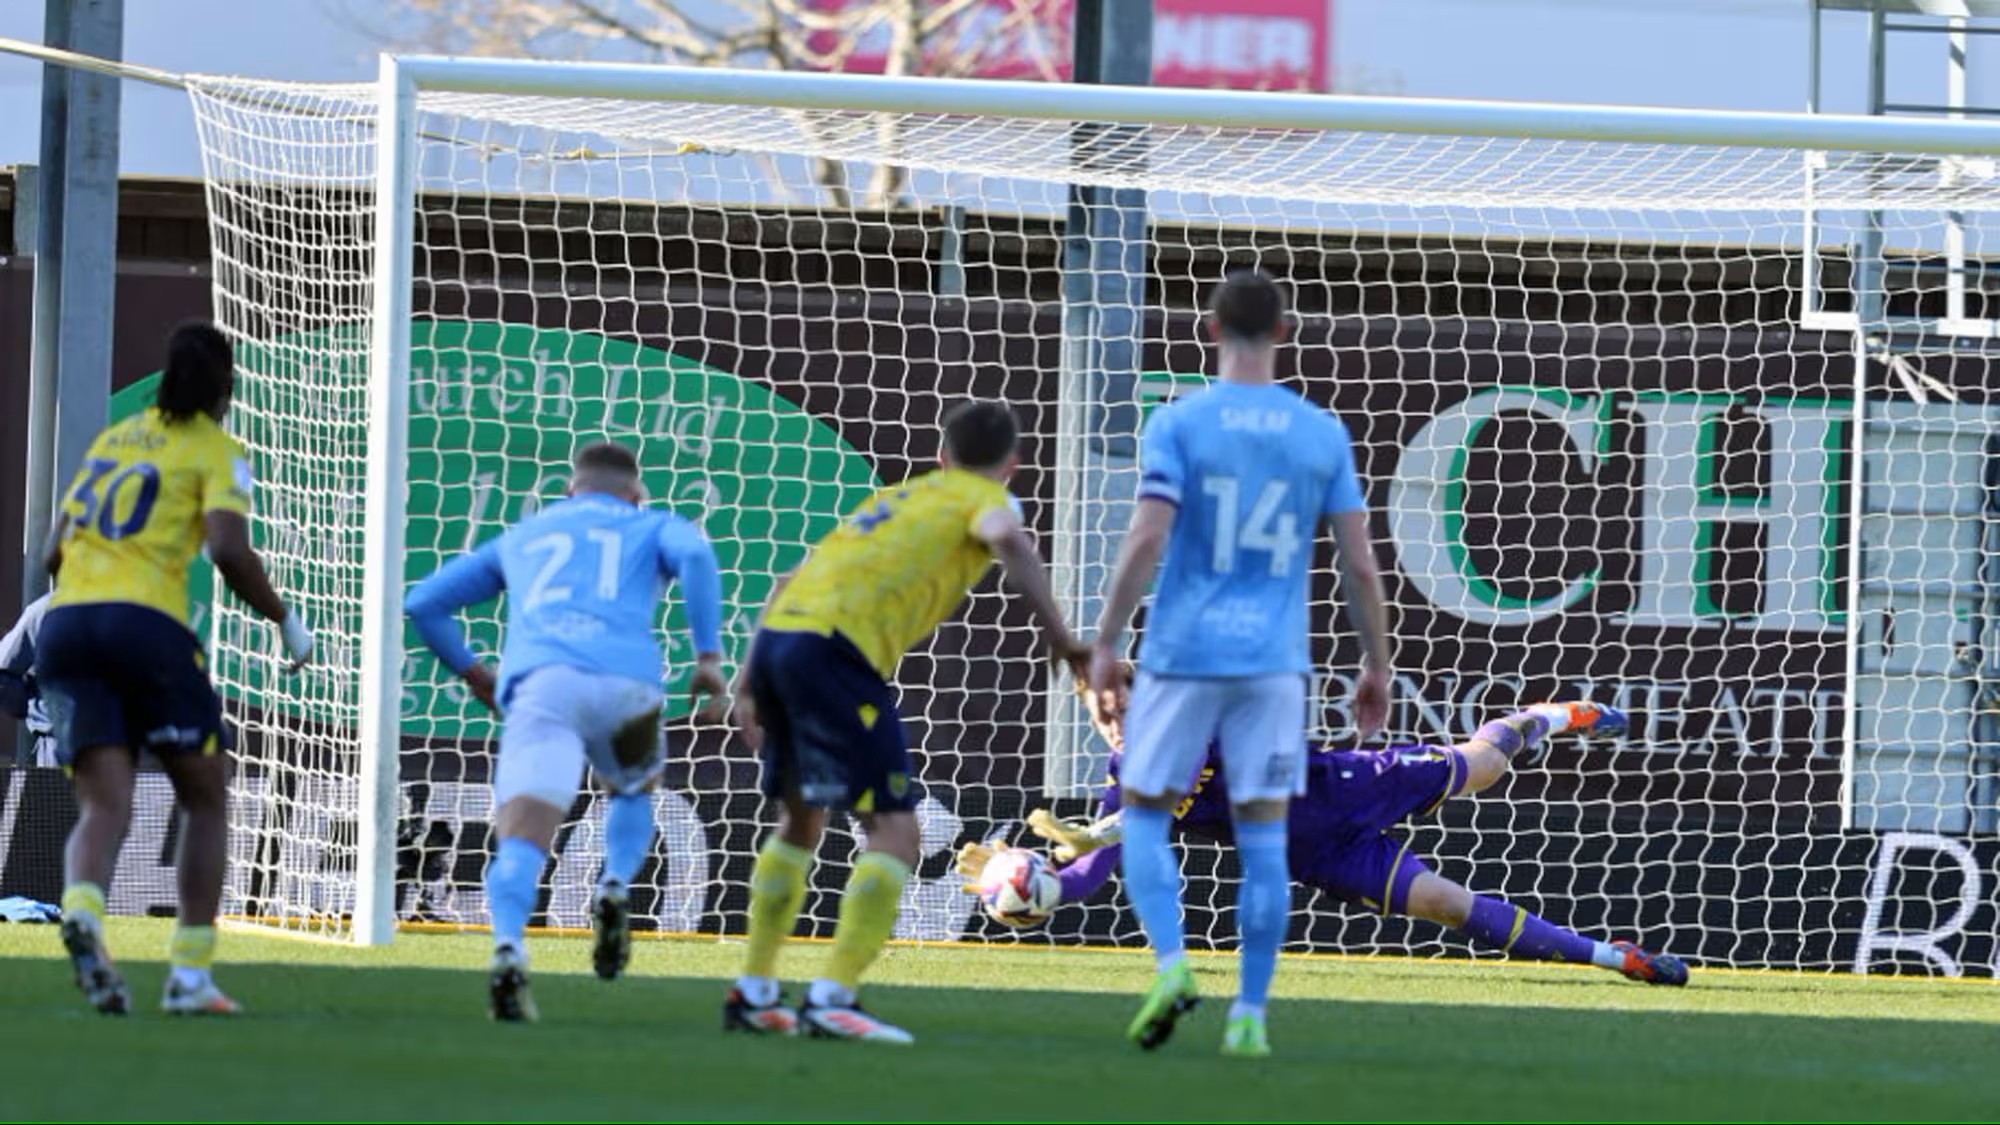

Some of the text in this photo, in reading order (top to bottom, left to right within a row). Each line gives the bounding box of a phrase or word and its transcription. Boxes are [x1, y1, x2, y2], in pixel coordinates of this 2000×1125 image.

[594, 362, 728, 458] Ltd
[71, 458, 161, 541] 30
[1202, 475, 1301, 578] 14
[521, 528, 622, 614] 21
